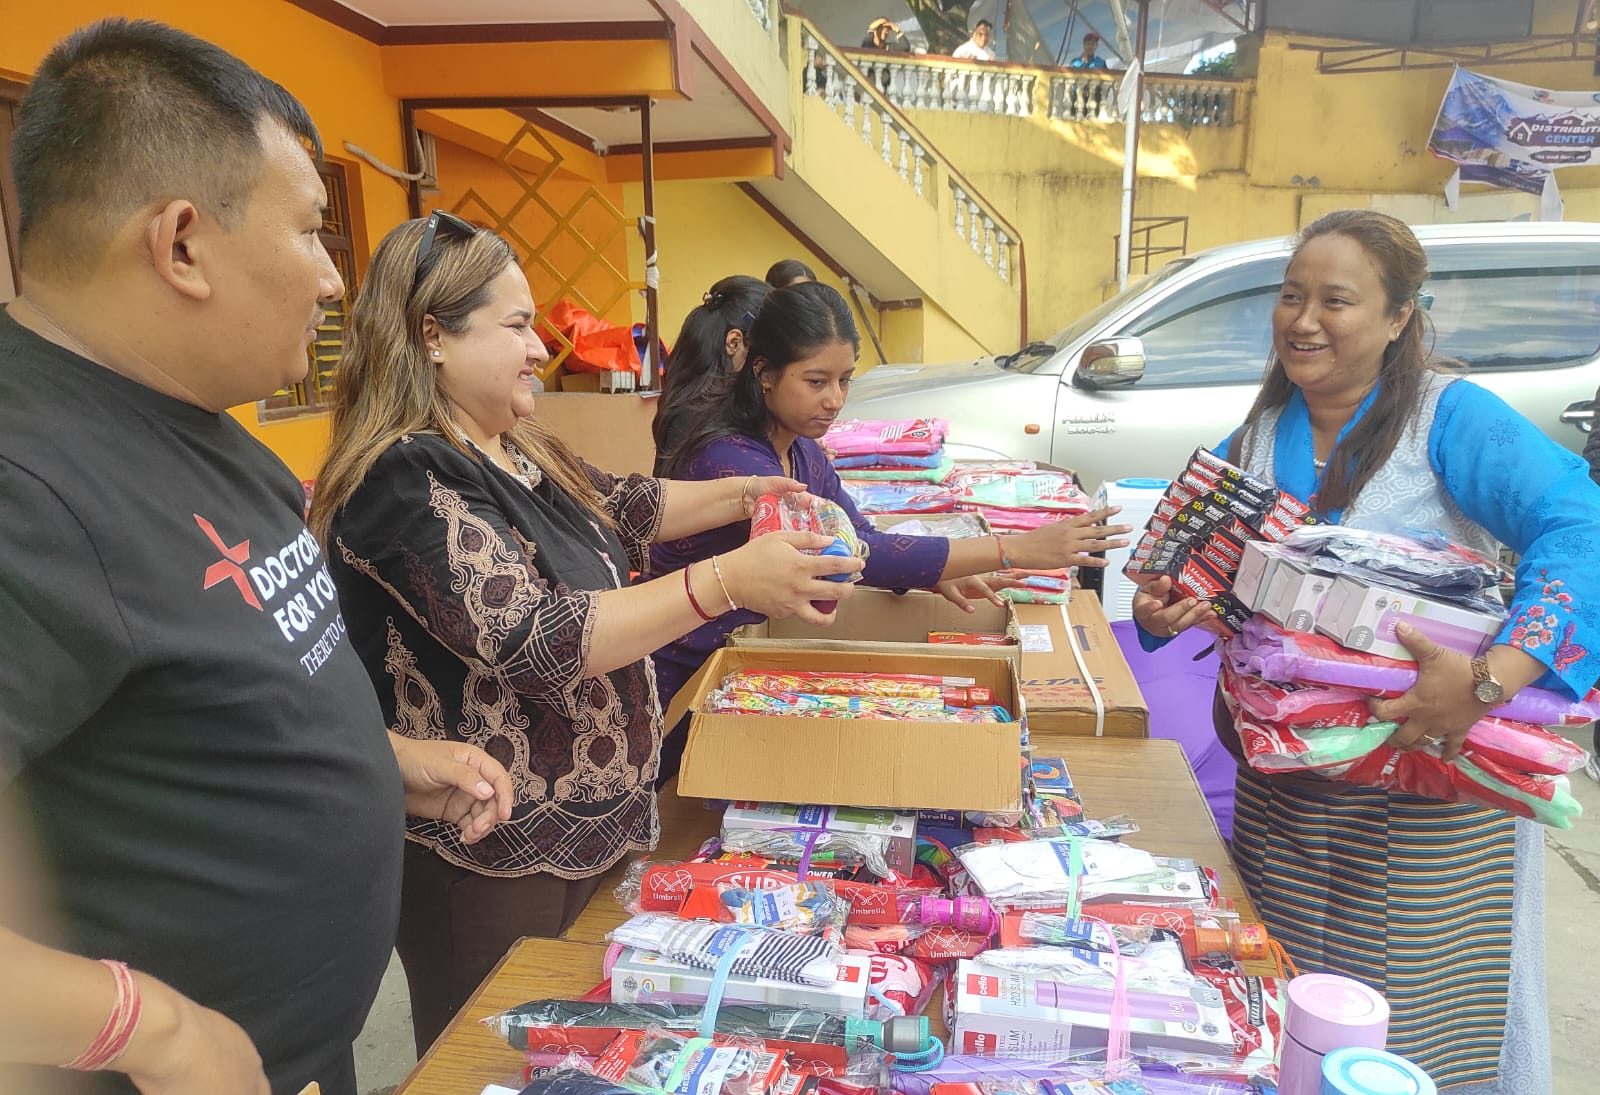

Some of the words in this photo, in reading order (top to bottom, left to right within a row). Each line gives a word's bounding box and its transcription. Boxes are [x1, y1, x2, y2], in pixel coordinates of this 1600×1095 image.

[1545, 135, 1595, 144] CENTER
[1204, 505, 1226, 519] POWER
[1280, 496, 1304, 516] Mortein
[1213, 540, 1241, 561] Mortein
[1206, 550, 1232, 571] Mortein
[1183, 573, 1209, 599] Mortein
[273, 592, 316, 642] FOR
[1355, 629, 1368, 647] 1000
[300, 630, 333, 676] THERE
[1020, 677, 1104, 686] LTAS
[919, 811, 955, 821] brella
[807, 870, 836, 878] OWER
[652, 892, 684, 902] Umbrell
[930, 950, 967, 959] Umbrella
[977, 975, 988, 996] cello
[1007, 1029, 1021, 1053] SLIM
